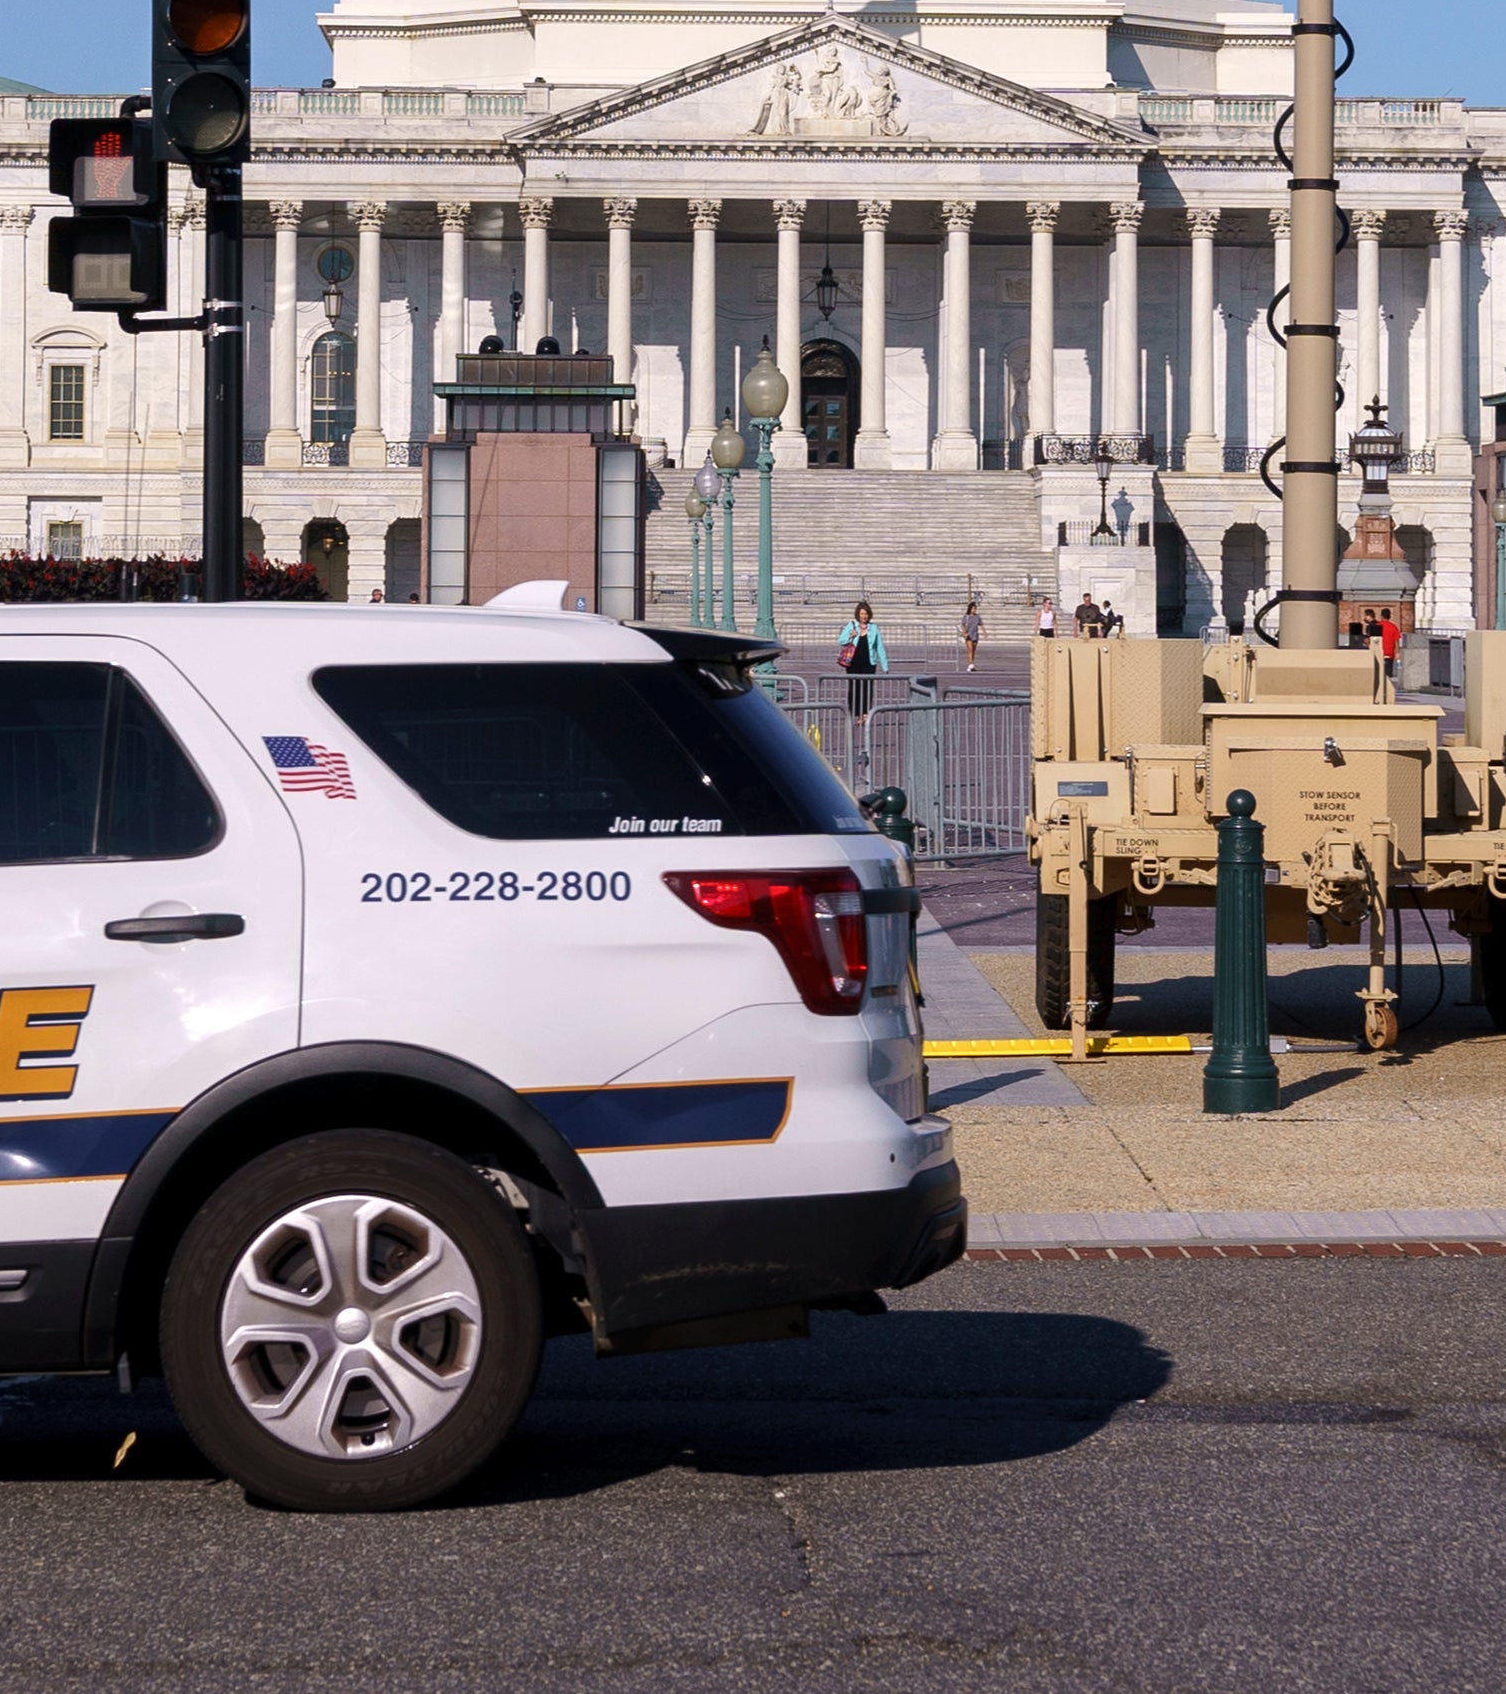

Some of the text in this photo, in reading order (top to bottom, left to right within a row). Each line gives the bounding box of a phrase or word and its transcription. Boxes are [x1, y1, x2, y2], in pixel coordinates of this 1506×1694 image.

[1299, 790, 1361, 800] STOW SENSOR
[1313, 802, 1346, 810] BEFORE
[1305, 813, 1355, 822] TRANSPORT
[608, 816, 723, 834] Join our team
[1116, 838, 1159, 847] TIE DOWN
[1494, 842, 1505, 850] TIE
[1115, 847, 1141, 855] SLING
[361, 871, 631, 903] 202-228-2800
